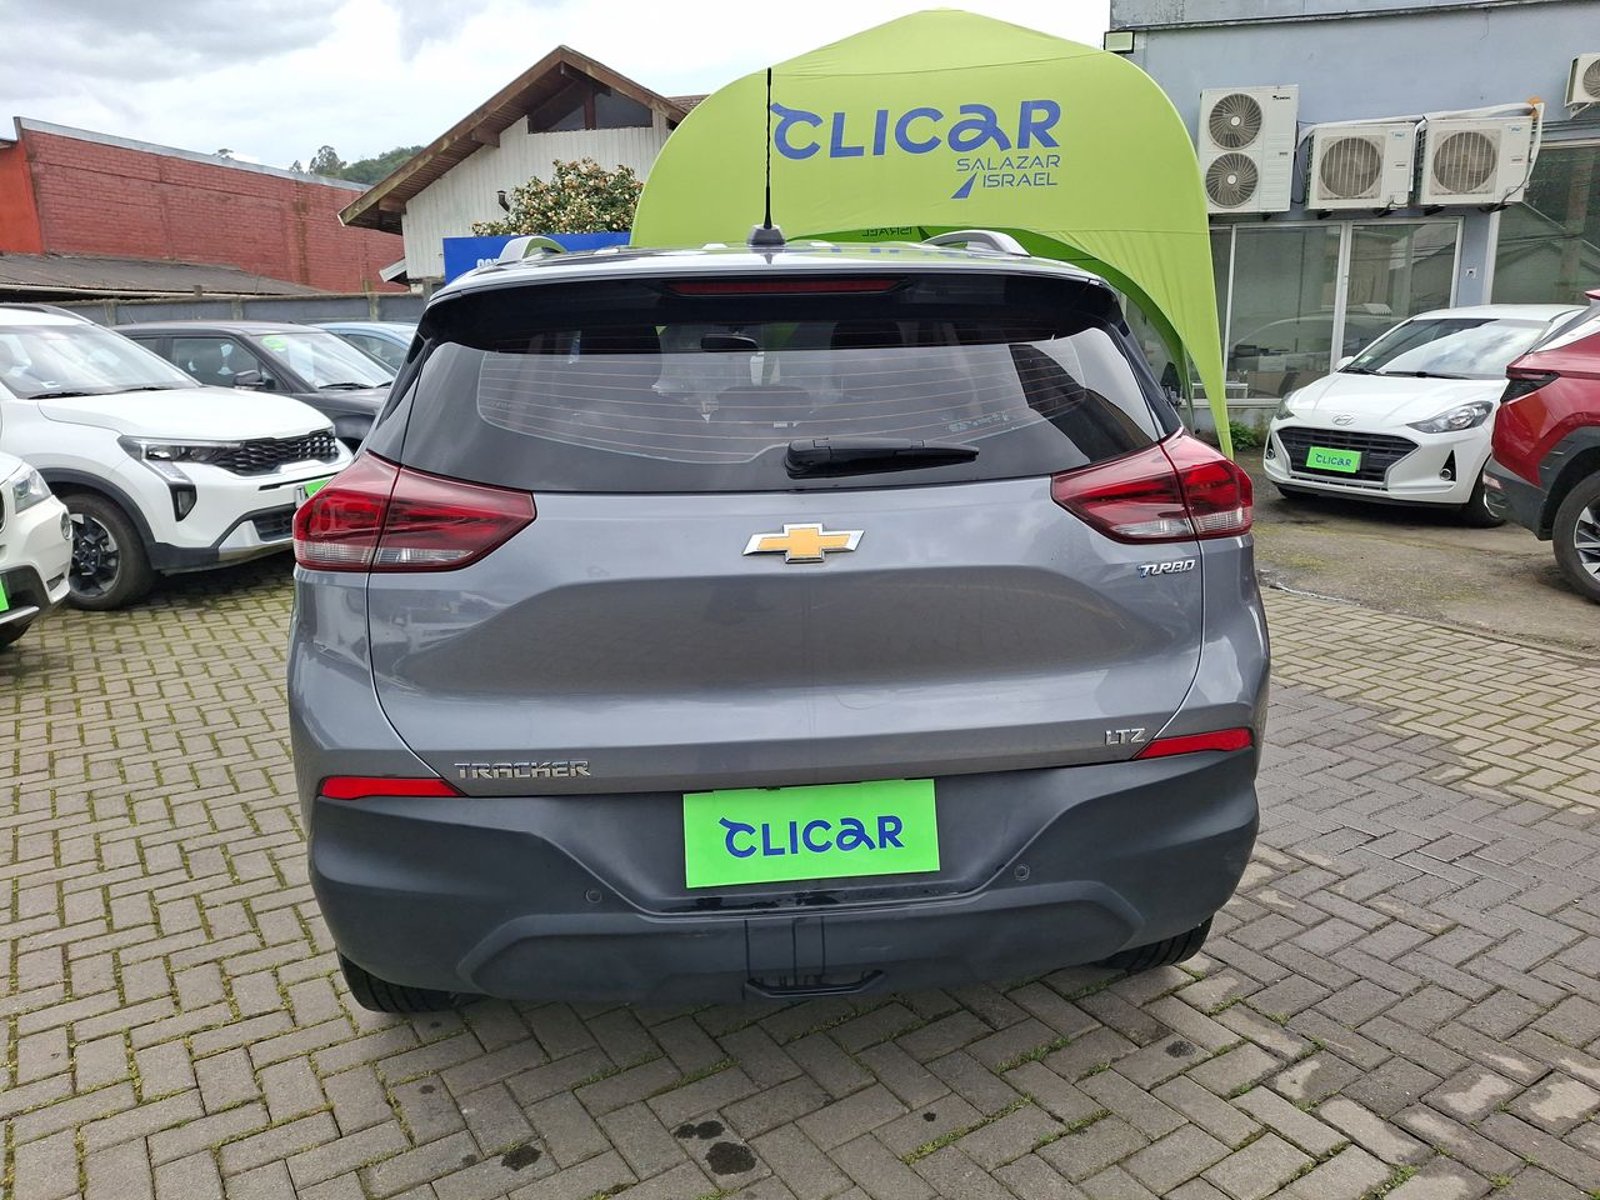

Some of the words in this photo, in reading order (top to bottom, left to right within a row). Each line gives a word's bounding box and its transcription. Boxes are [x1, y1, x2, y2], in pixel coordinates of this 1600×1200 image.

[956, 154, 1061, 172] SALAZAR
[982, 172, 1058, 188] ISRAEL
[1138, 560, 1196, 579] TURBO
[1105, 728, 1146, 745] LTZ
[454, 760, 592, 779] TRACKER
